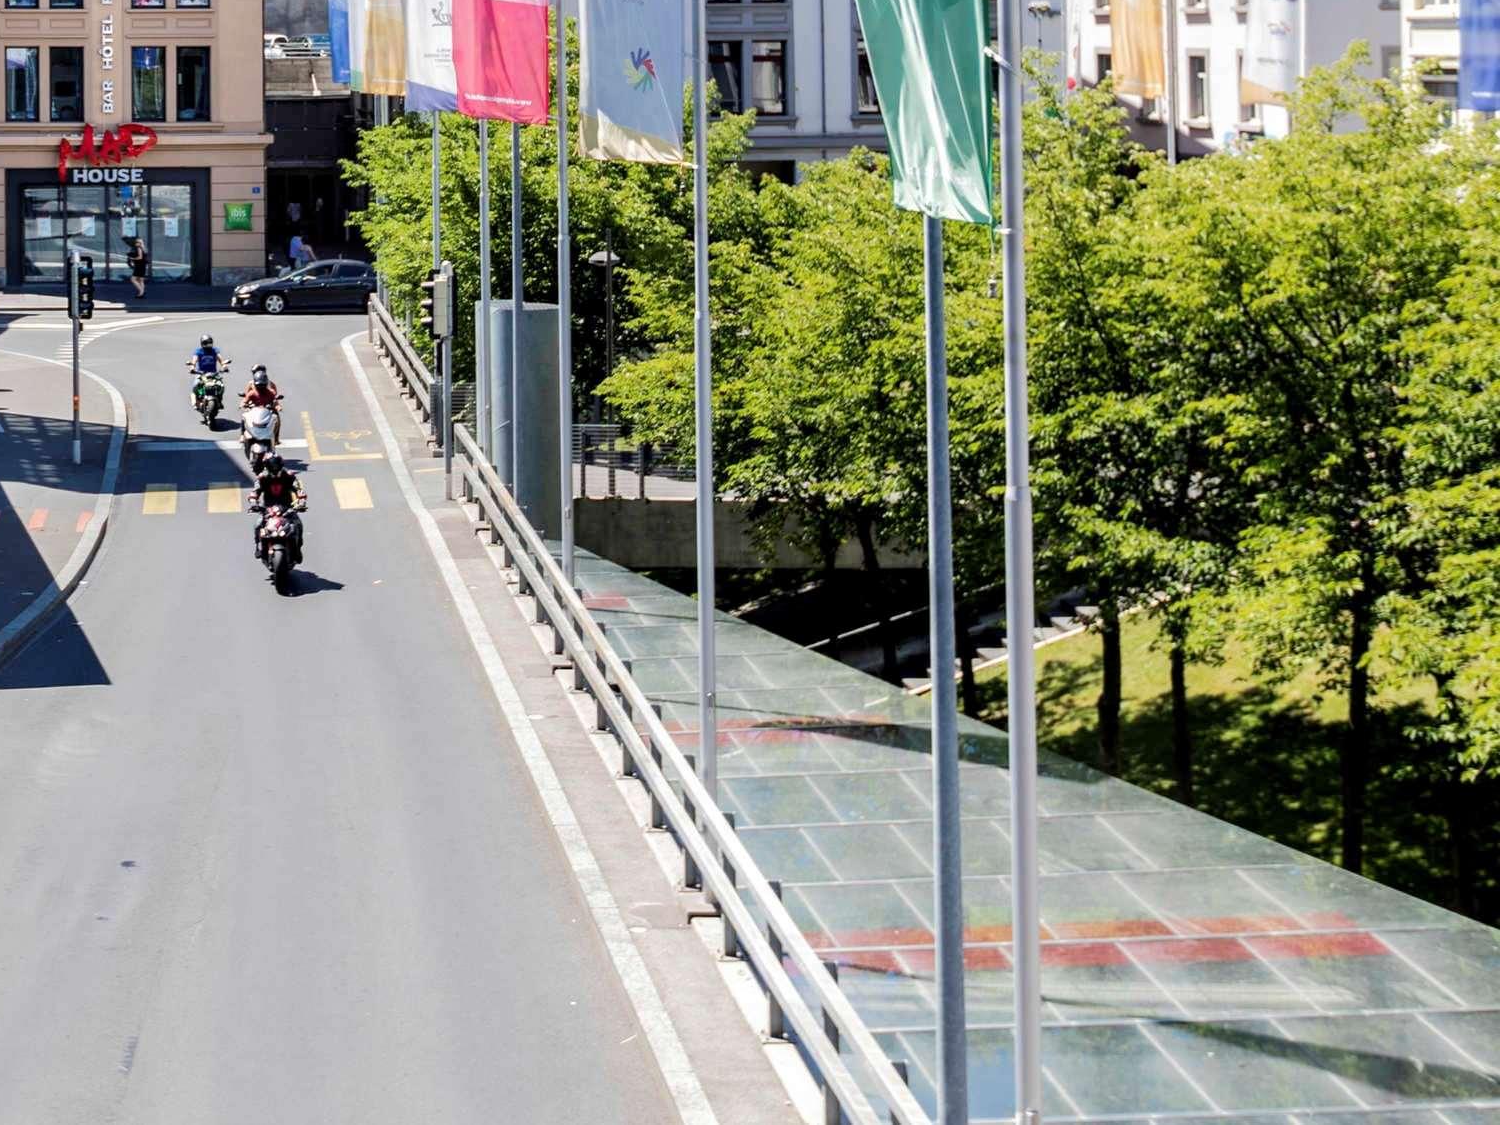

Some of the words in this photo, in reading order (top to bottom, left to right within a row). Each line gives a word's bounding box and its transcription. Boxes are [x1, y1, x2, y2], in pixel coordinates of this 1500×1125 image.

[98, 15, 114, 70] HÔTEL
[102, 80, 115, 114] BAR
[58, 123, 158, 183] MAD
[73, 169, 144, 183] HOUSE
